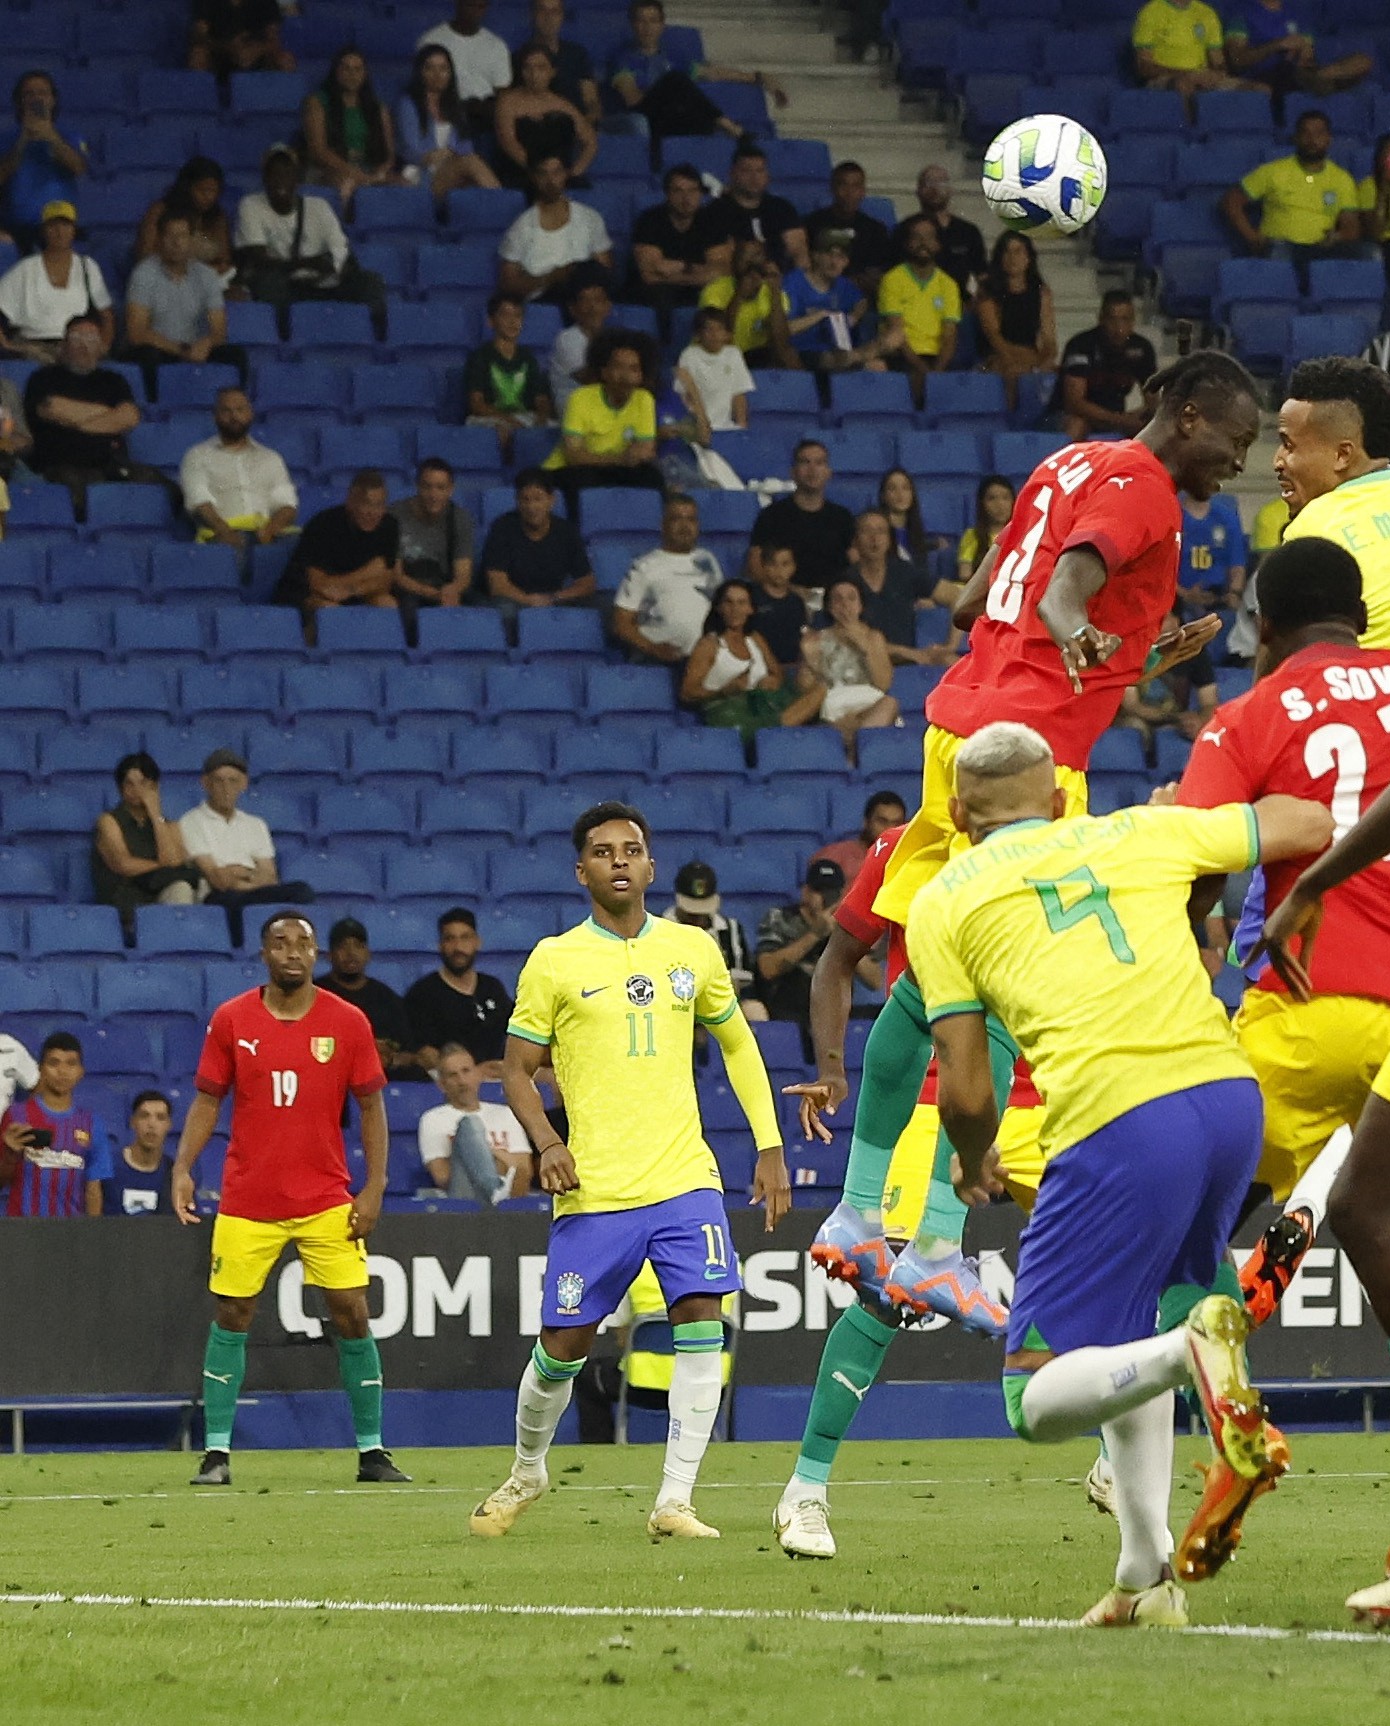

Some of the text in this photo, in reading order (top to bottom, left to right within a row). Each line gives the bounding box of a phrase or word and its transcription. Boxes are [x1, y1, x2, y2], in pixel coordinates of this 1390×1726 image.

[1023, 864, 1137, 965] 4
[625, 1012, 657, 1057] 11
[271, 1069, 298, 1107] 19
[701, 1223, 727, 1269] 11
